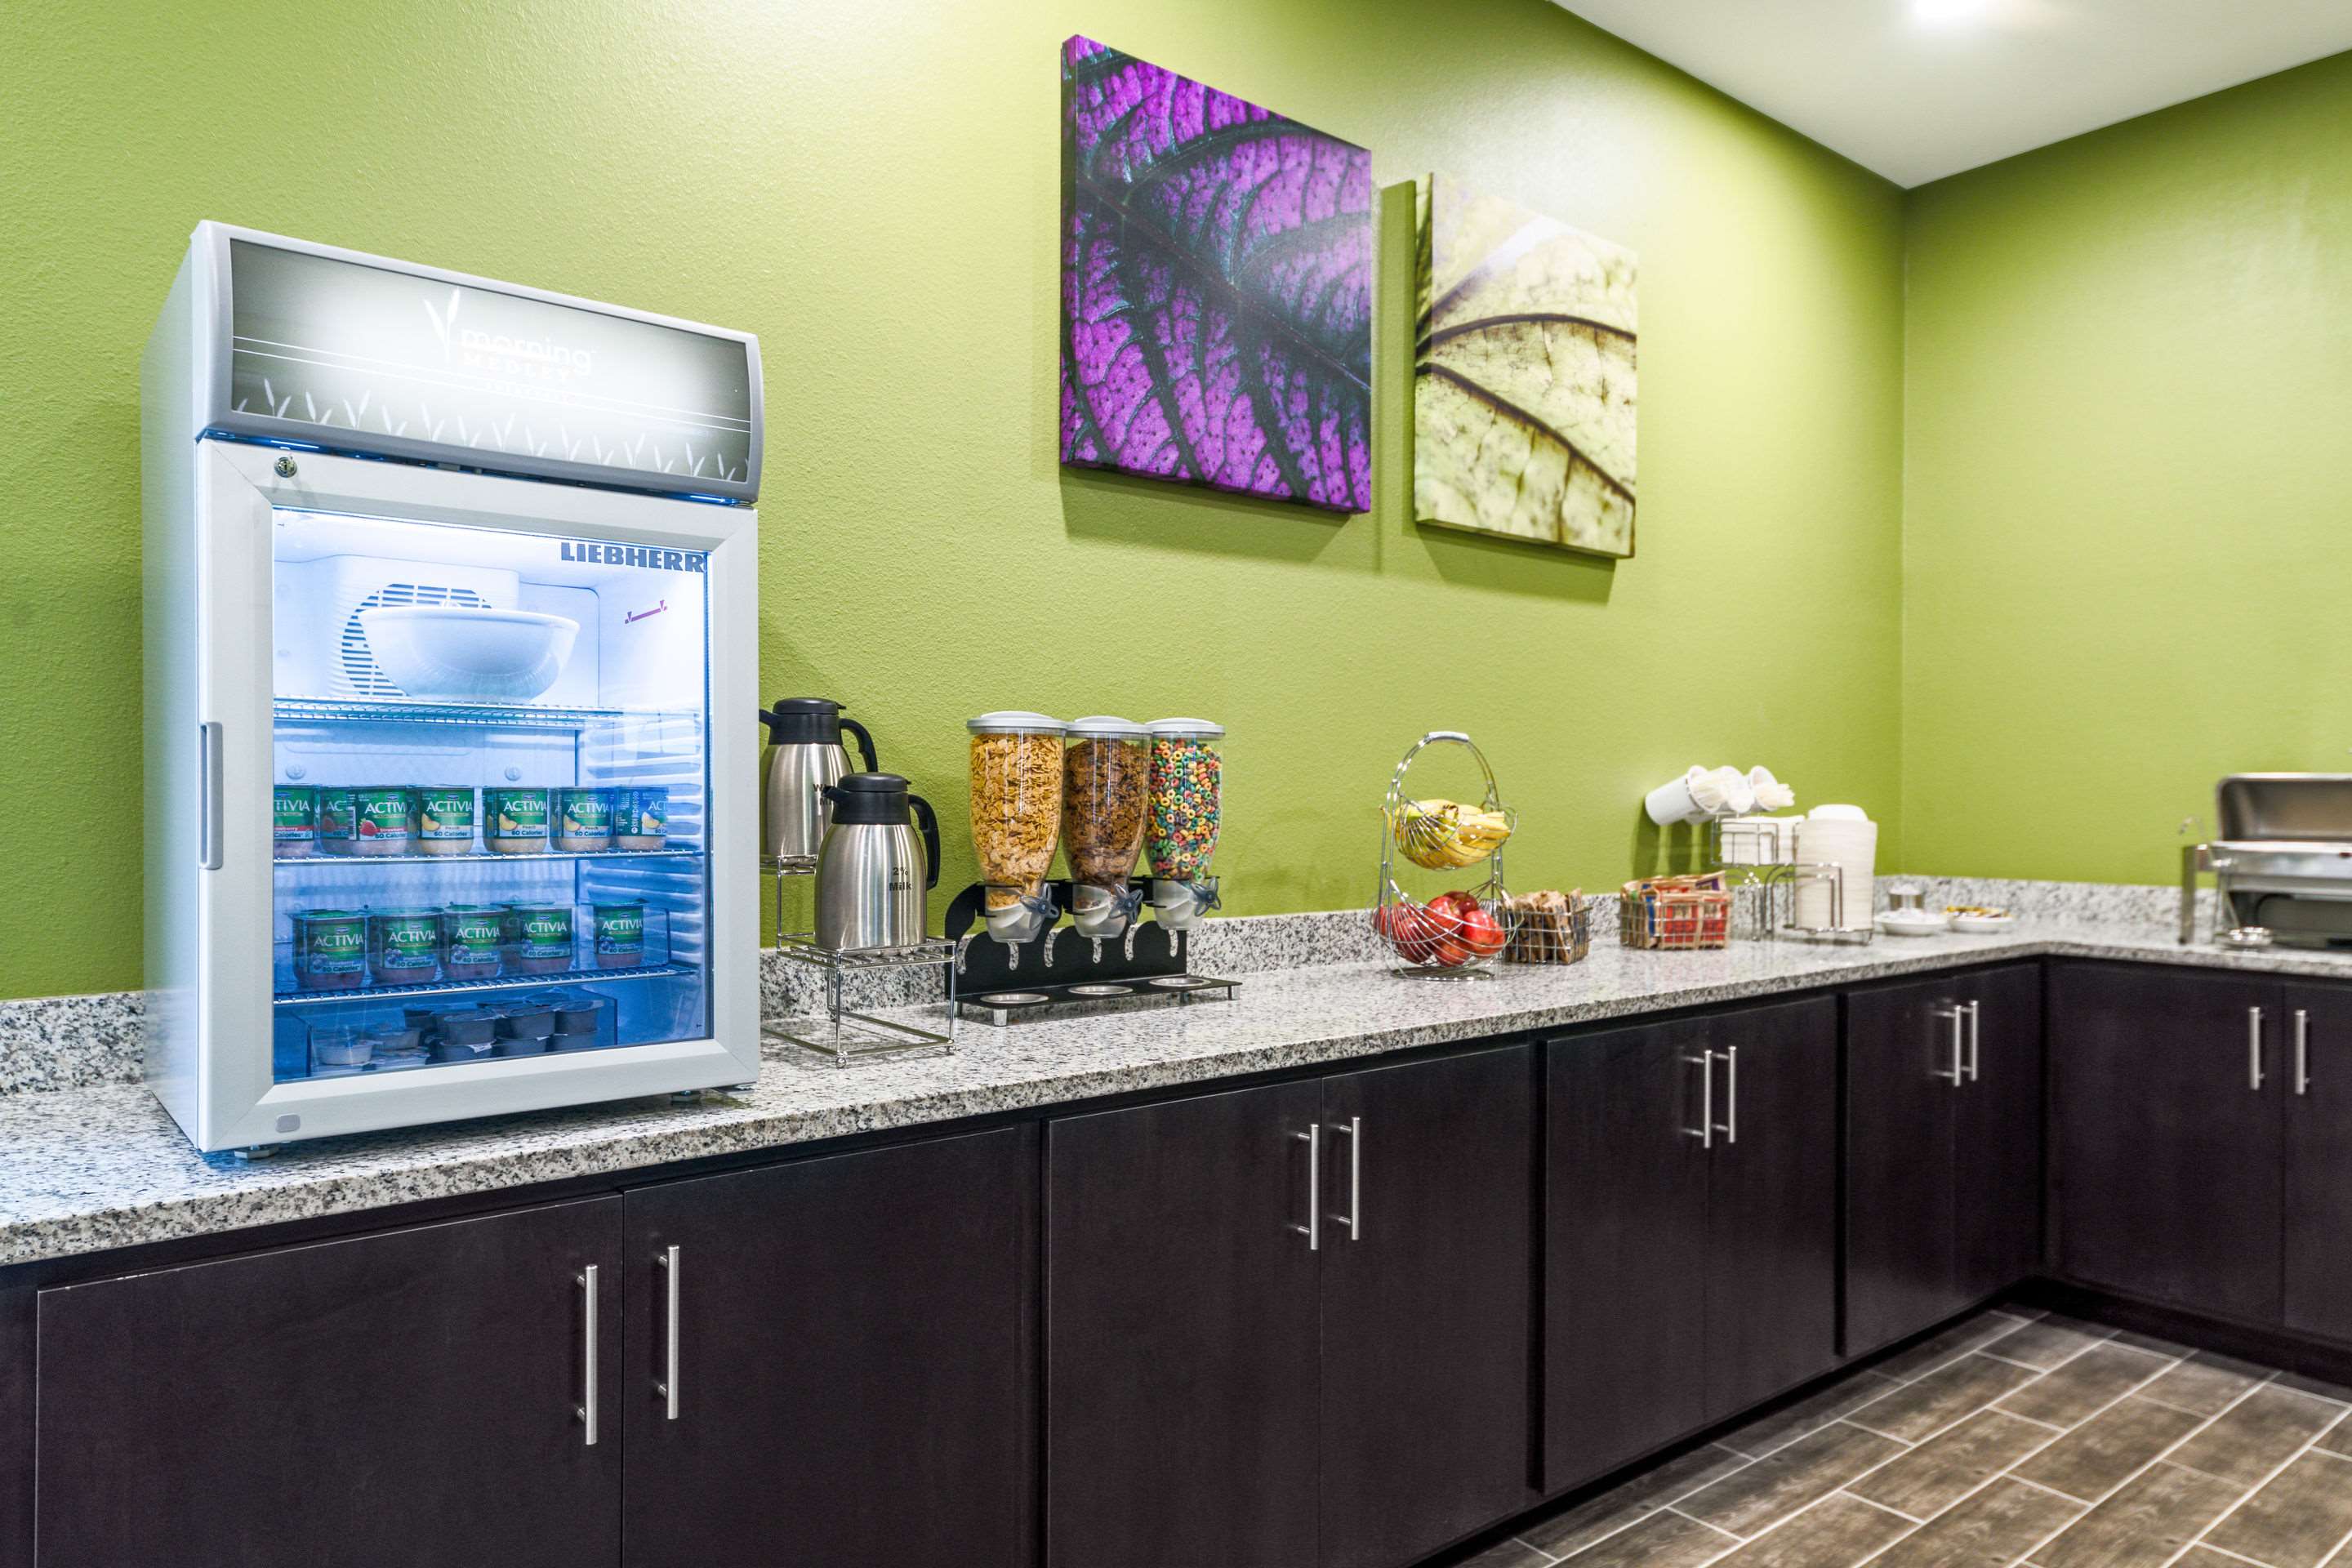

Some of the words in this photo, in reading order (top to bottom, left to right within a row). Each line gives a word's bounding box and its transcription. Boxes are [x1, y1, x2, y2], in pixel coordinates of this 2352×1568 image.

[461, 329, 591, 377] morning
[561, 541, 705, 572] LIEBHERR
[426, 800, 473, 813] ACTIVIA
[568, 802, 610, 813] ACTIVIA
[893, 866, 909, 876] 2%
[889, 881, 912, 891] Milk
[523, 920, 568, 933] ACTIVIA
[602, 919, 643, 931] ACTIVIA
[388, 929, 437, 942] ACTIVIA
[456, 926, 501, 939] ACTIVIA
[314, 933, 364, 947] ACTIVIA
